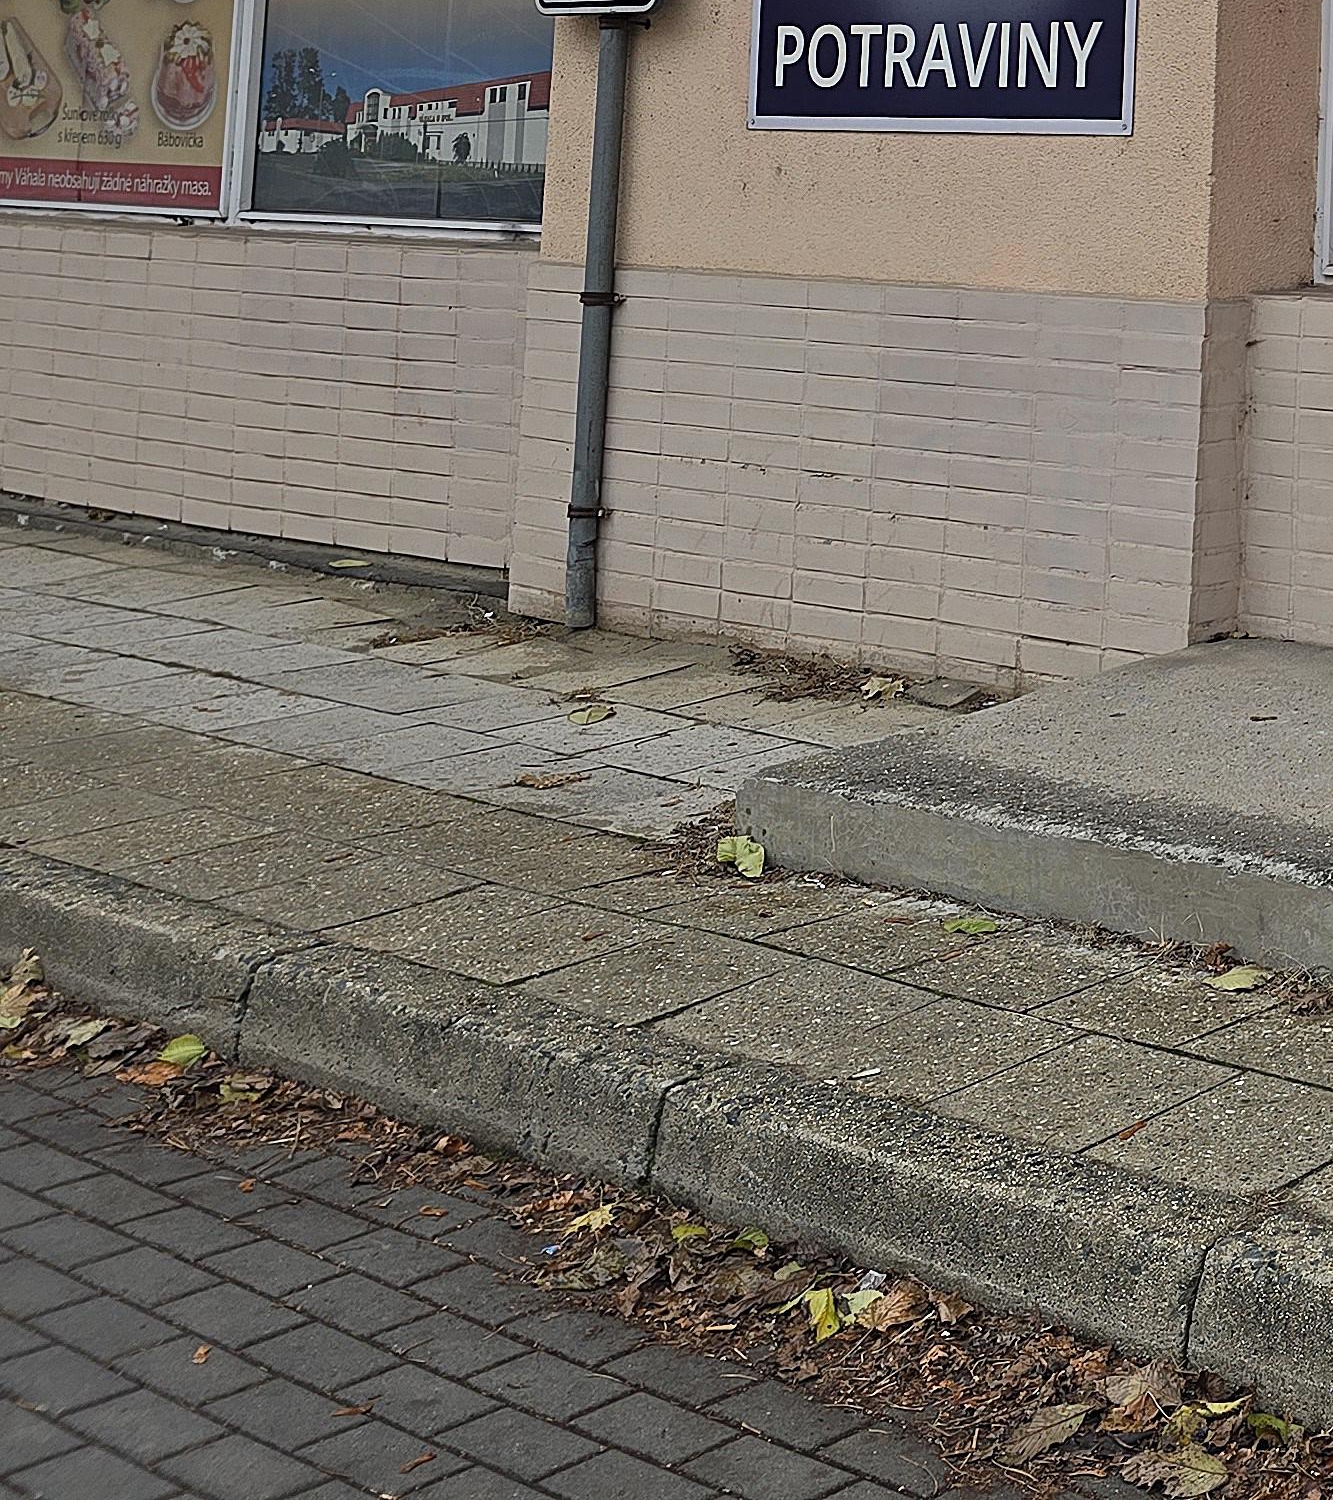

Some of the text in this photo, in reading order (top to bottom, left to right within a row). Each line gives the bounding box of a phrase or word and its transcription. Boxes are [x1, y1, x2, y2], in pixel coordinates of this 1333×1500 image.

[775, 20, 1104, 89] POTRAVINY
[15, 167, 46, 187] Váhala
[181, 180, 212, 197] masa.
